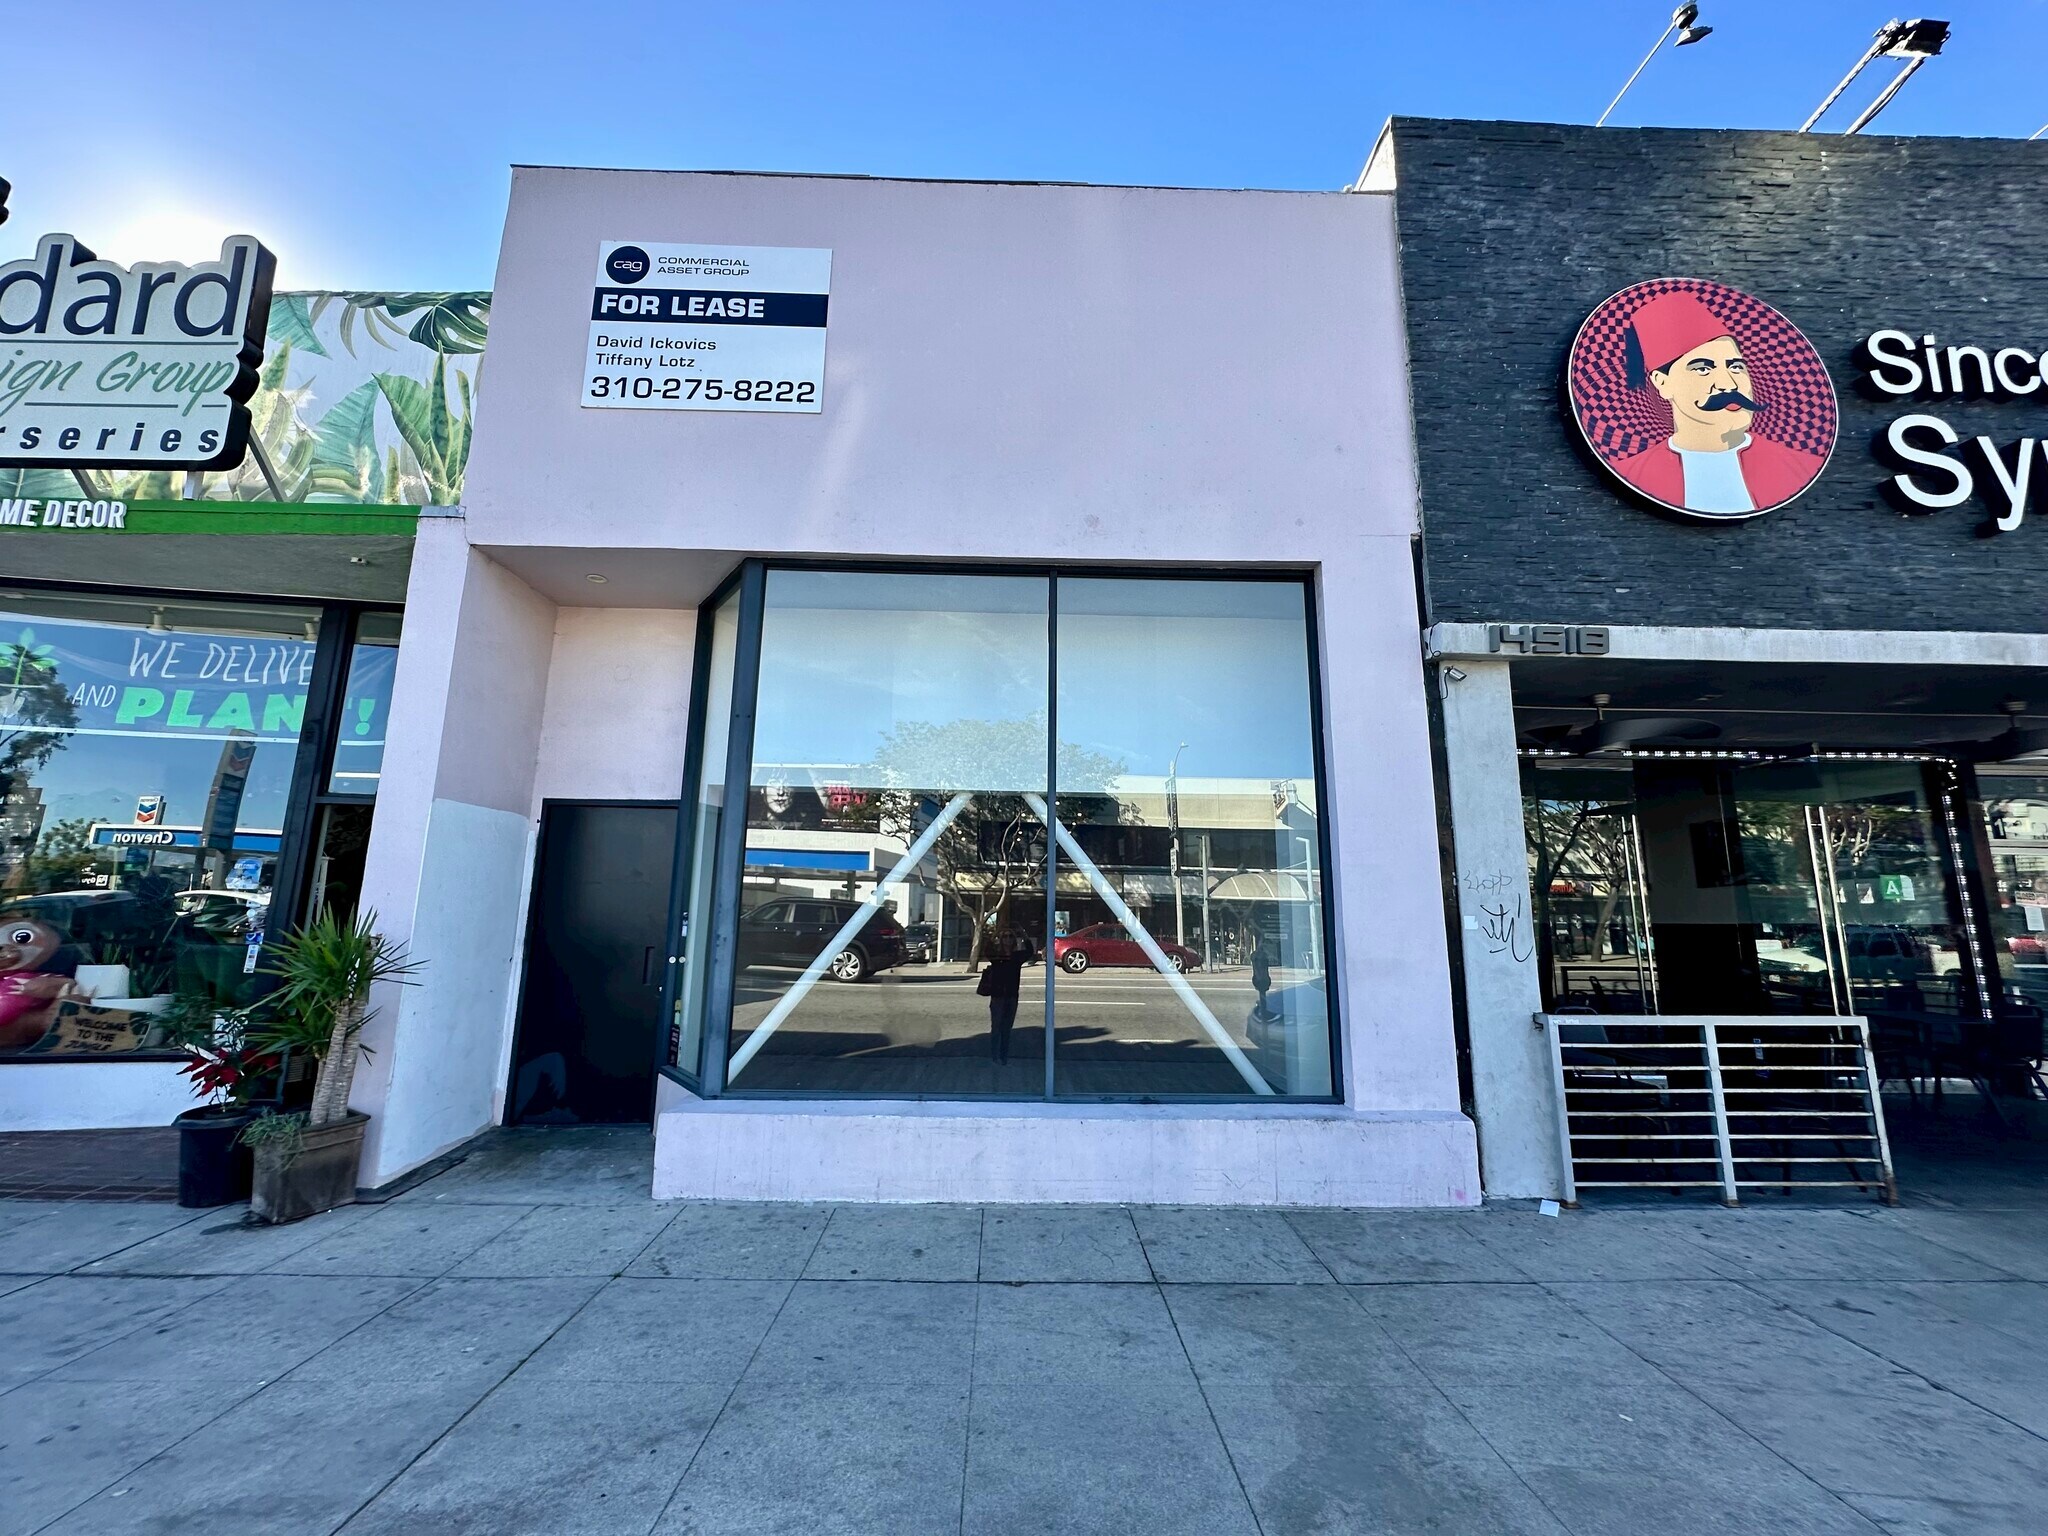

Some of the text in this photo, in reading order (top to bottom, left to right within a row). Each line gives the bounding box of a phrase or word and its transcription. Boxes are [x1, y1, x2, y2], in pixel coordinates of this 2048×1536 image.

[613, 259, 643, 273] cag
[657, 266, 750, 276] ASSET GROUP
[658, 256, 750, 267] COMMERCIAL
[0, 243, 248, 337] dard
[600, 293, 765, 318] FOR LEASE
[596, 335, 717, 351] David Ickovics
[596, 353, 696, 370] Tiffany Lotz
[1868, 329, 2048, 394] Sinc
[95, 350, 236, 417] Group
[590, 376, 815, 403] 310-275-8222
[1888, 414, 2048, 532] Sy
[0, 498, 127, 529] ME DECOR
[1488, 624, 1610, 655] 14518
[129, 637, 186, 679] WE
[71, 682, 117, 708] AND
[77, 1028, 117, 1043] TO THE
